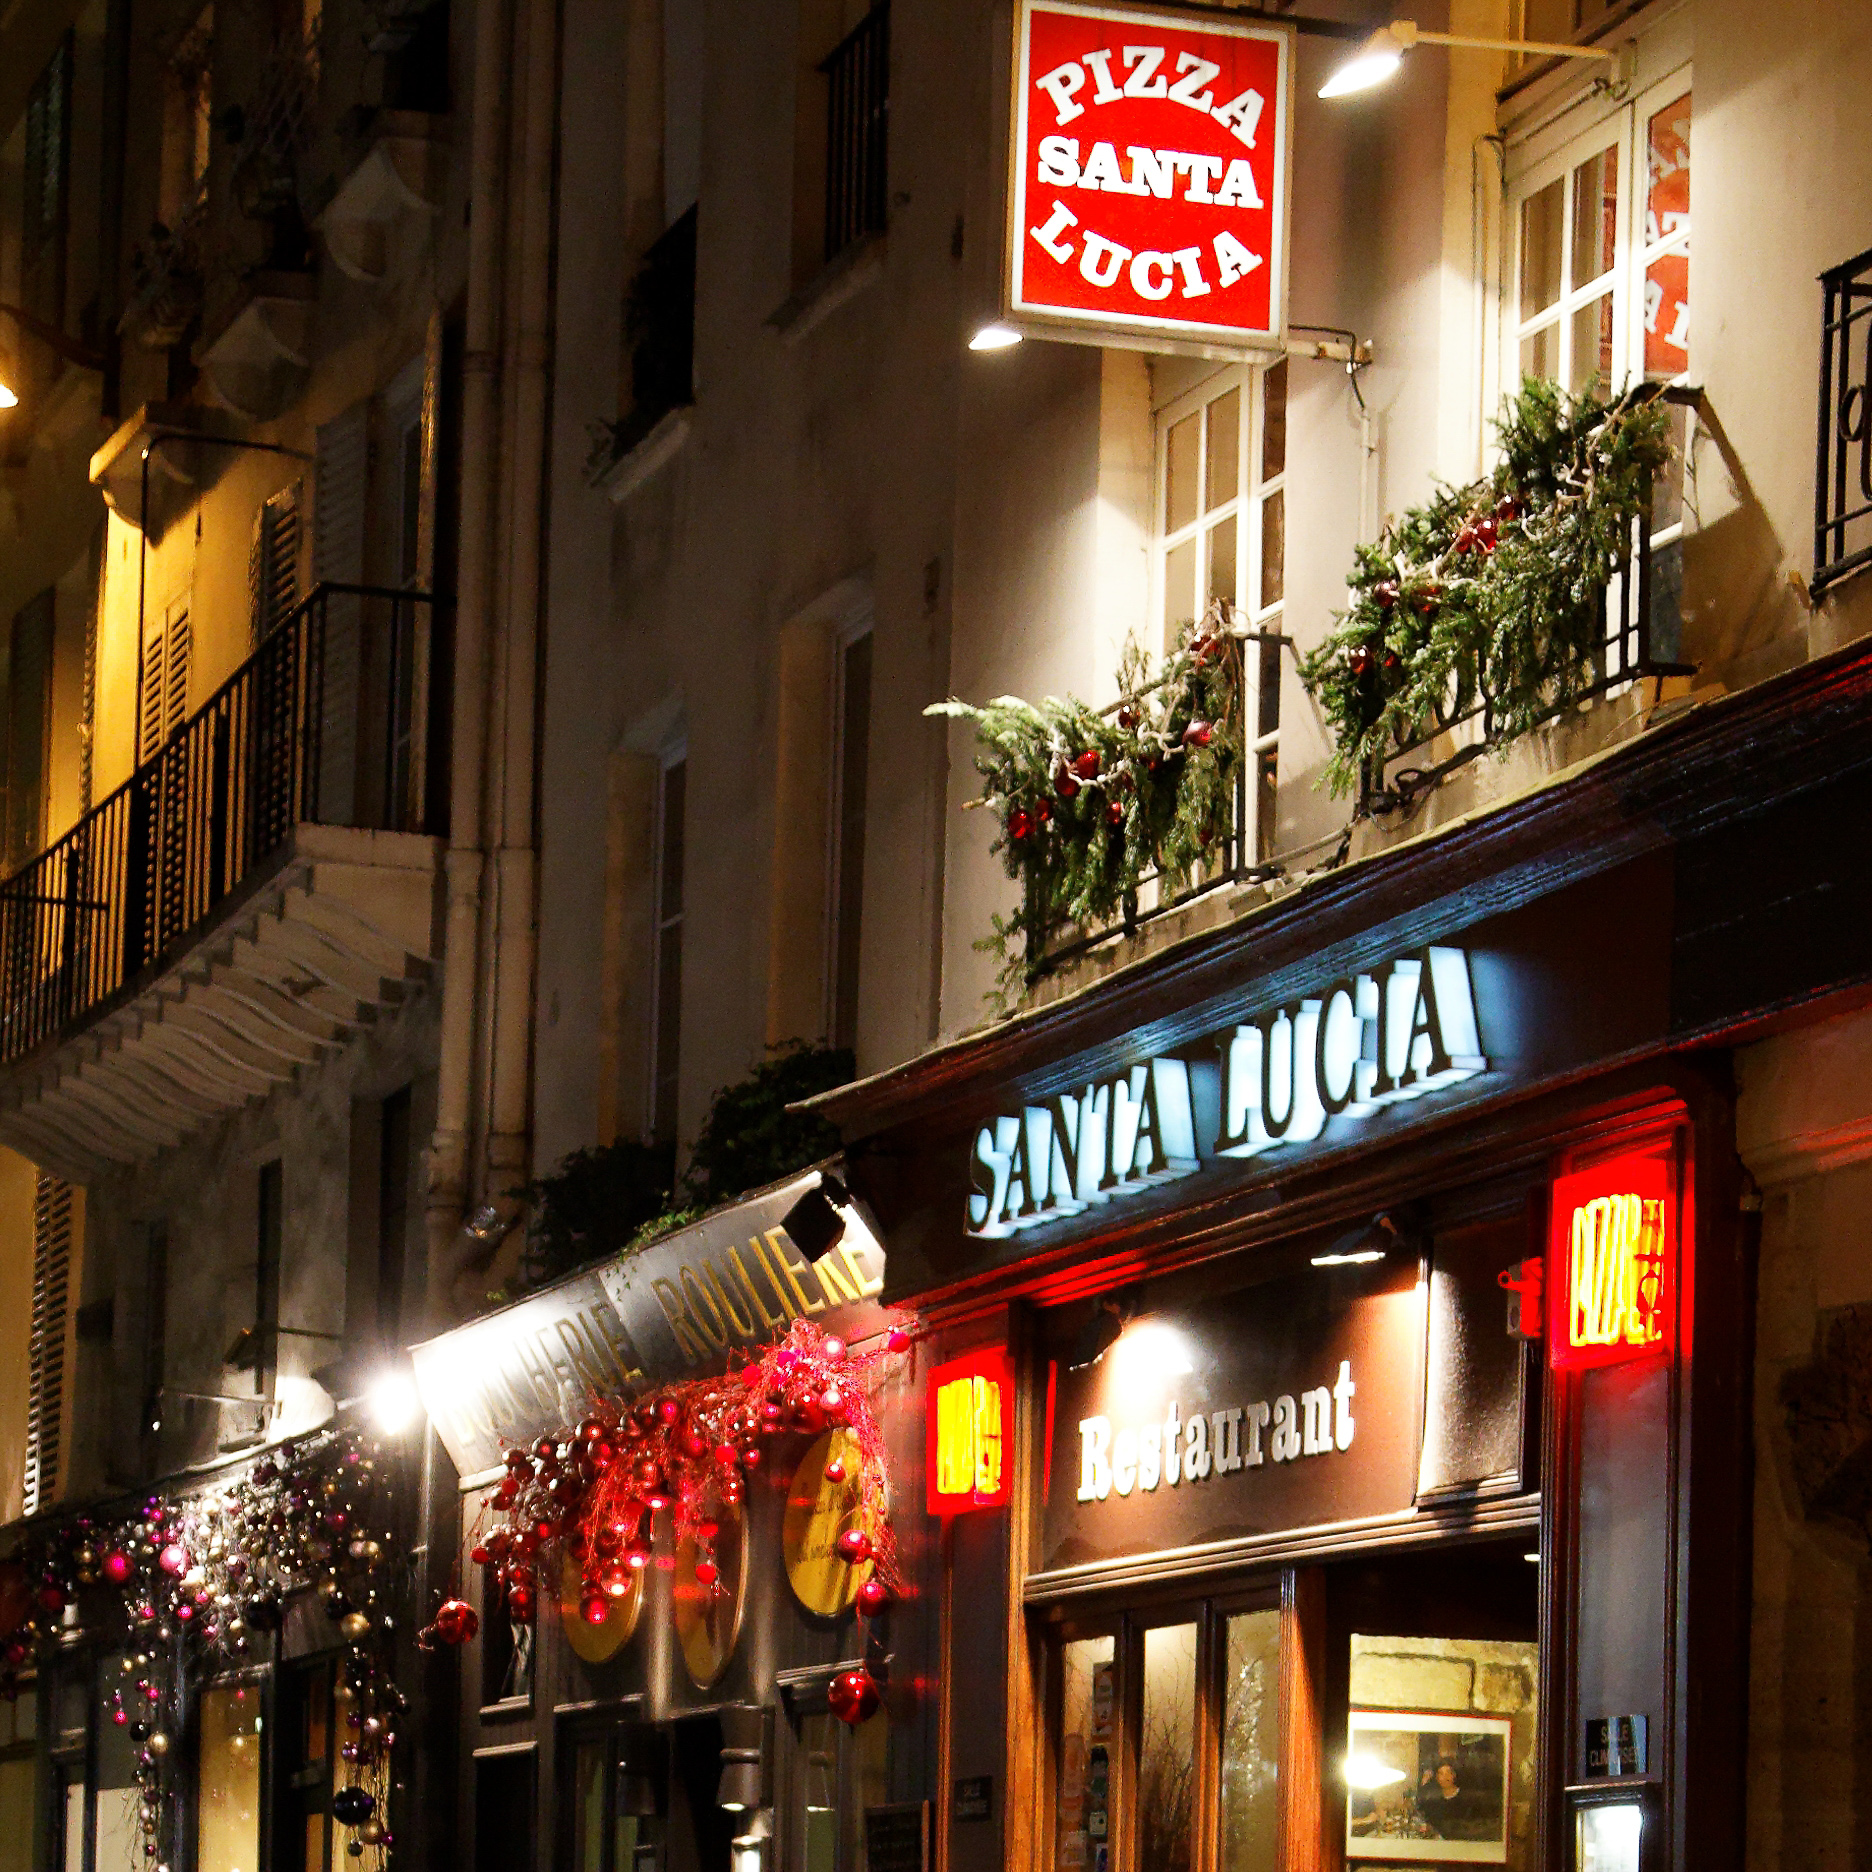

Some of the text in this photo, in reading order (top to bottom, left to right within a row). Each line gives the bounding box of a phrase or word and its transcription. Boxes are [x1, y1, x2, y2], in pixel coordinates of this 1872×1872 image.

[1035, 45, 1265, 149] PIZZA
[1037, 134, 1264, 210] SANTA
[1030, 200, 1262, 302] LUCIA
[965, 944, 1490, 1238] SANTA LUCIA
[1076, 1359, 1357, 1506] Restaurant
